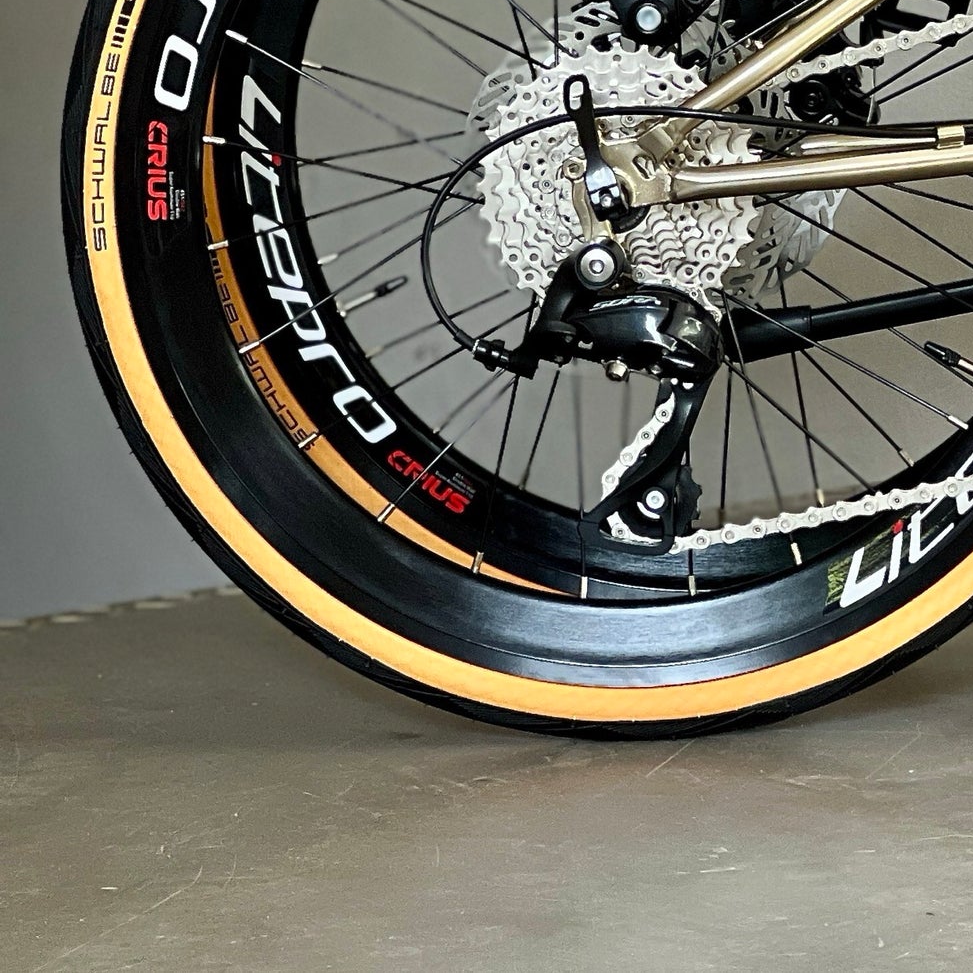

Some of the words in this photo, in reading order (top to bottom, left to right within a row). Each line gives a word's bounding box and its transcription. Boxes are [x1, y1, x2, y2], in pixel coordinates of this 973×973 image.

[92, 53, 120, 251] SCHWALBE
[147, 121, 168, 221] CRIUS
[388, 450, 470, 514] CRIUS
